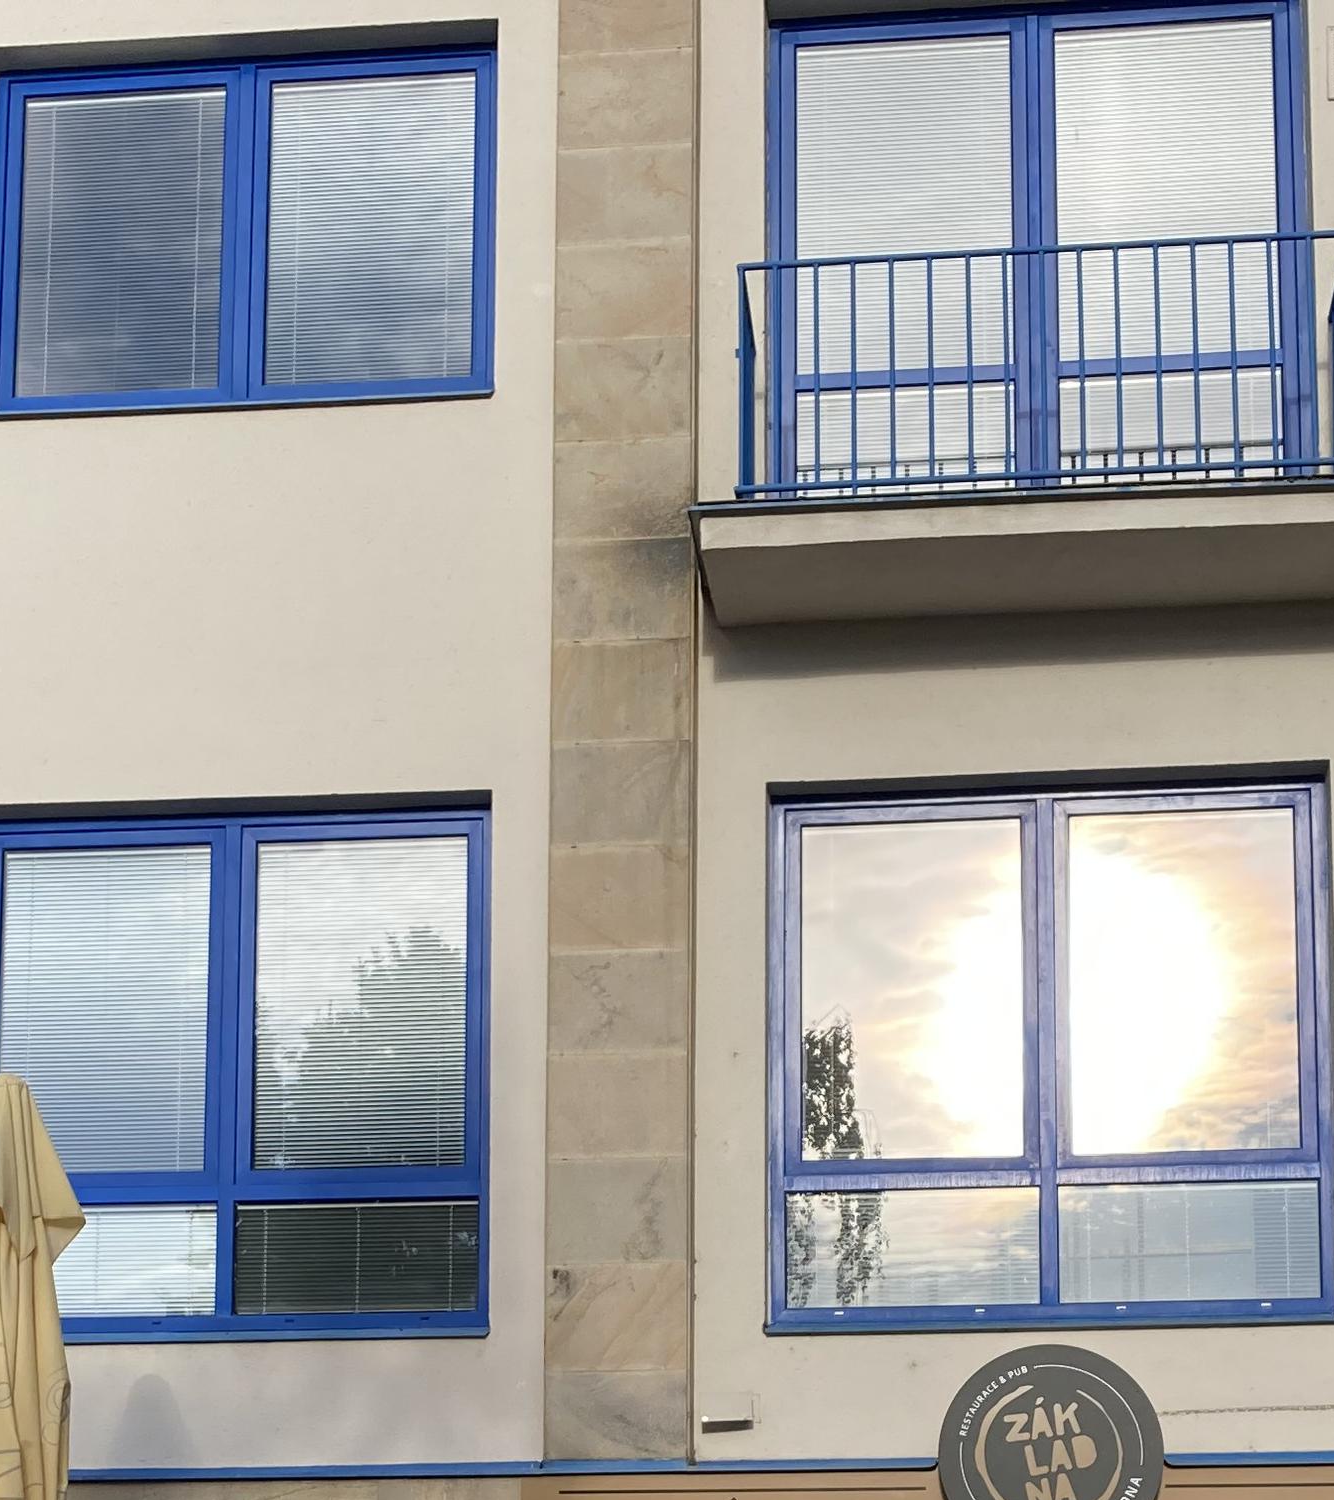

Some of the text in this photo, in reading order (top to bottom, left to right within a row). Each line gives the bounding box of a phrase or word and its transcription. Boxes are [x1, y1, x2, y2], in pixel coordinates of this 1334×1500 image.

[959, 1364, 1029, 1438] RESTAURACE & PUB
[1003, 1396, 1082, 1443] ZÁK
[1023, 1434, 1098, 1477] LAD
